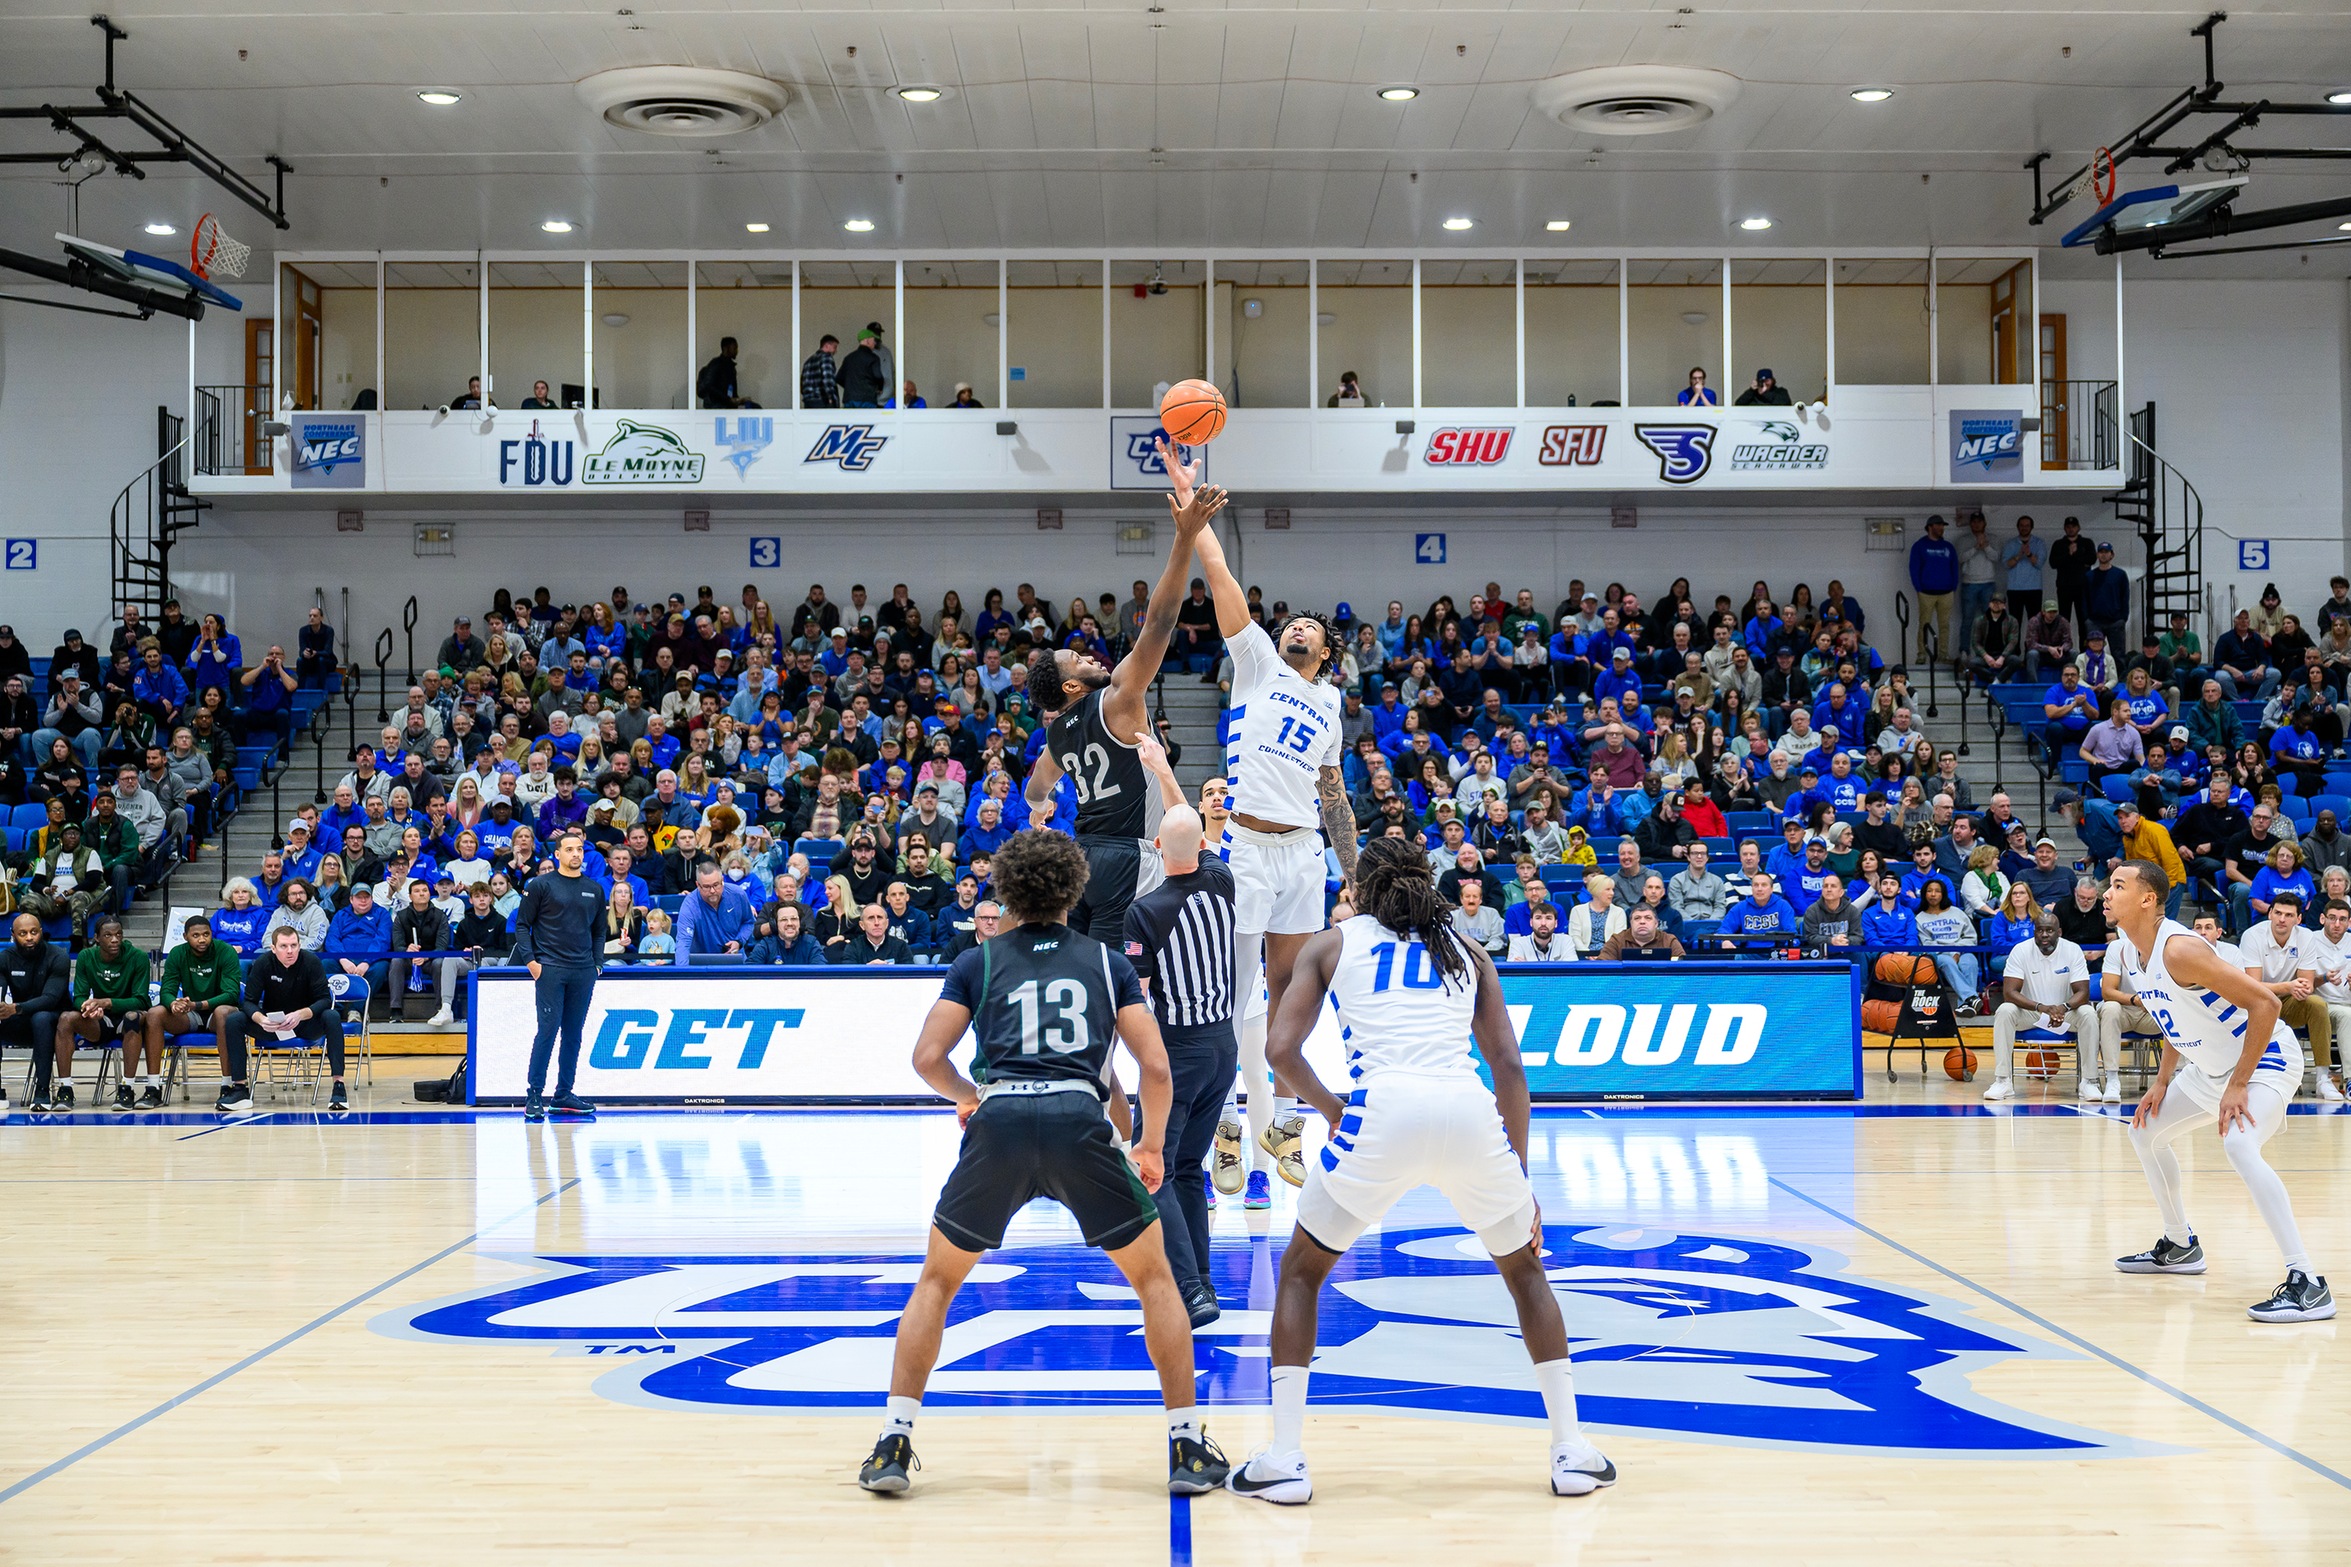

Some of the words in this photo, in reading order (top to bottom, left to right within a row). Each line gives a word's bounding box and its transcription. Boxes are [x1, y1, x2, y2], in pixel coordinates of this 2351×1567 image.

[715, 417, 774, 446] LIU
[1539, 425, 1607, 466] SFU
[1956, 431, 2018, 460] NEC
[297, 436, 360, 465] NEC
[804, 425, 888, 471] MC
[1425, 427, 1515, 466] SHU
[1732, 444, 1829, 463] WAGNER
[499, 439, 573, 486] FDU
[1730, 462, 1825, 470] SEAHAWKS
[10, 541, 33, 567] 2
[754, 539, 777, 566] 3
[1419, 535, 1444, 562] 4
[2243, 542, 2266, 568] 5
[1065, 714, 1079, 729] NEC
[1269, 691, 1330, 733] CENTRAL
[1276, 715, 1317, 753] 15
[1061, 742, 1122, 805] 32
[1744, 911, 1779, 931] CCSU
[1922, 918, 1960, 930] CENTRAL
[1033, 940, 1059, 952] NEC
[1370, 942, 1443, 993] 10
[1007, 978, 1089, 1055] 13
[1912, 996, 1941, 1008] ROCK
[589, 1008, 806, 1070] GET
[1506, 1003, 1768, 1066] LOUD
[585, 1344, 675, 1354] TM
